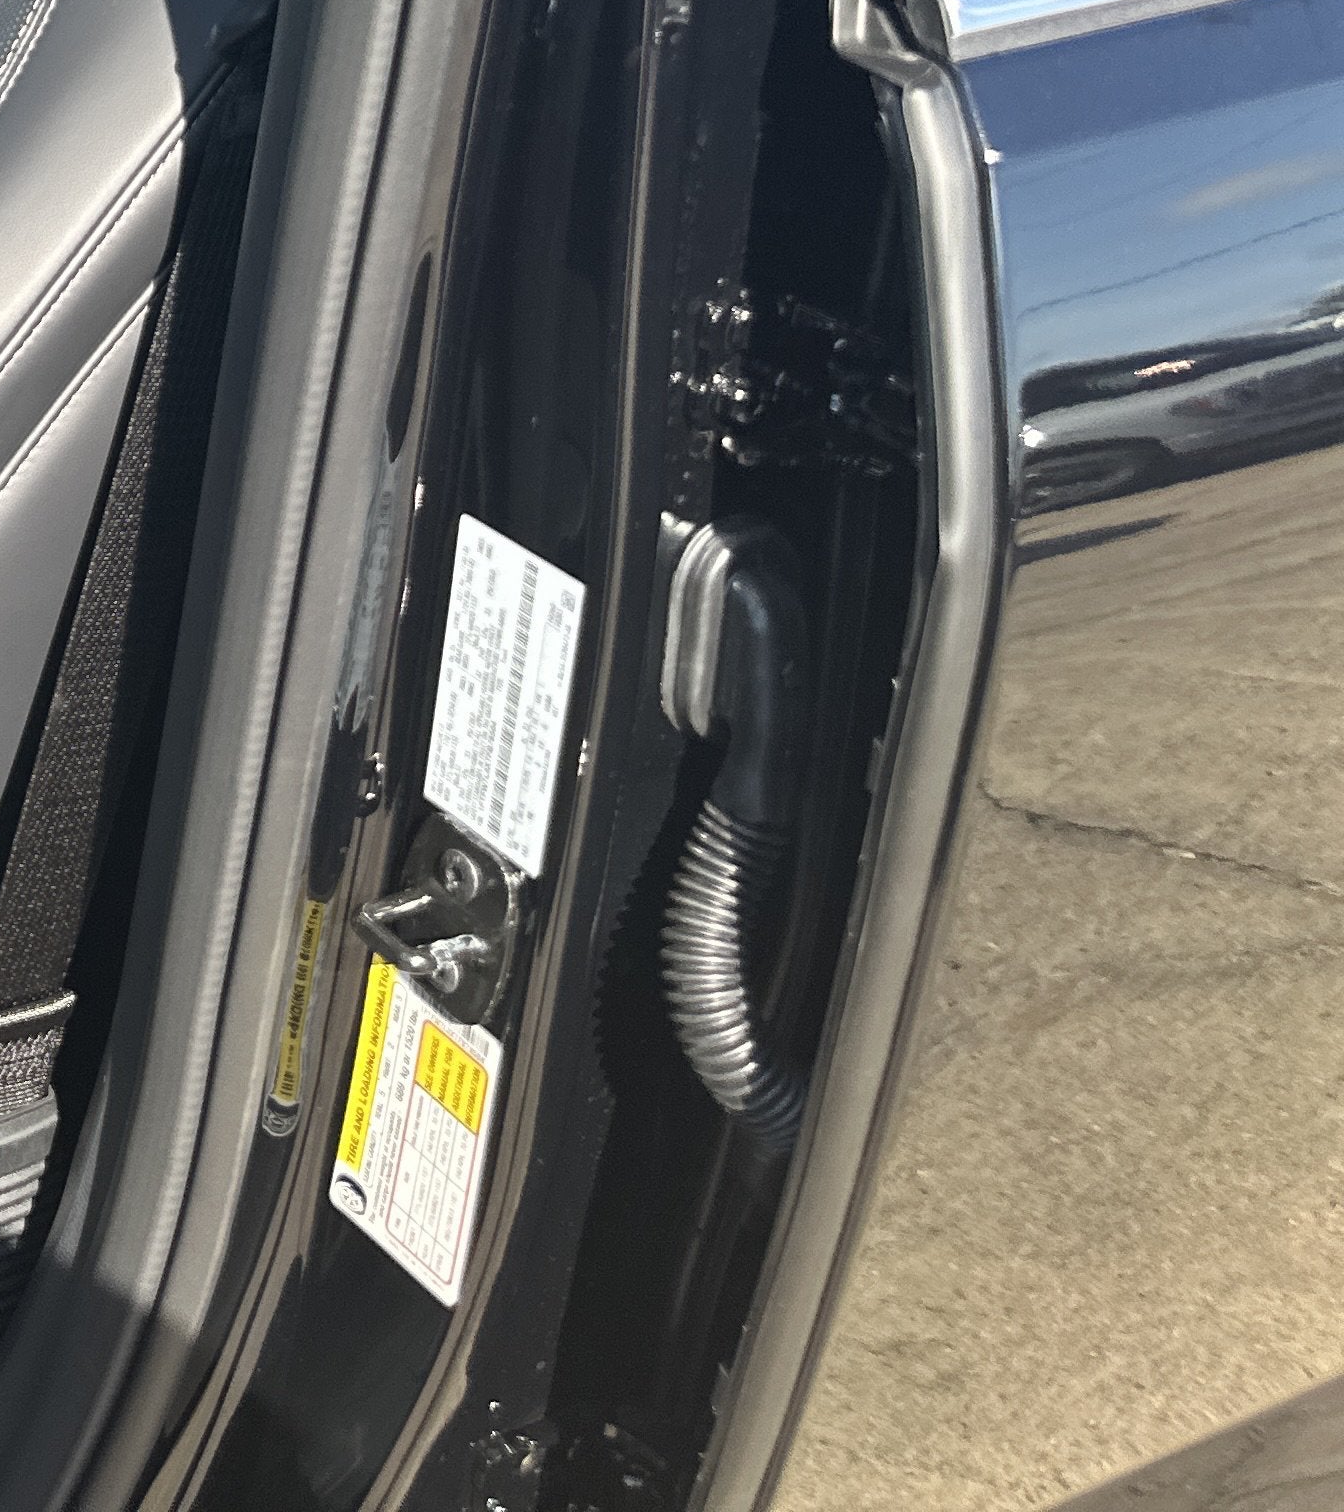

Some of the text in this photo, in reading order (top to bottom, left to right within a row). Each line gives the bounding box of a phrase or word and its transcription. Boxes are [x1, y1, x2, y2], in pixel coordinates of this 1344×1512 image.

[403, 1023, 415, 1052] 1520
[443, 1045, 453, 1066] FOR
[347, 963, 391, 1165] TIRE AND LOADING INFORMATIO
[398, 1063, 409, 1081] kg
[437, 1064, 450, 1103] MANUAL
[450, 1059, 466, 1112] ADDITIONAL
[463, 1065, 481, 1127] INFORMATION
